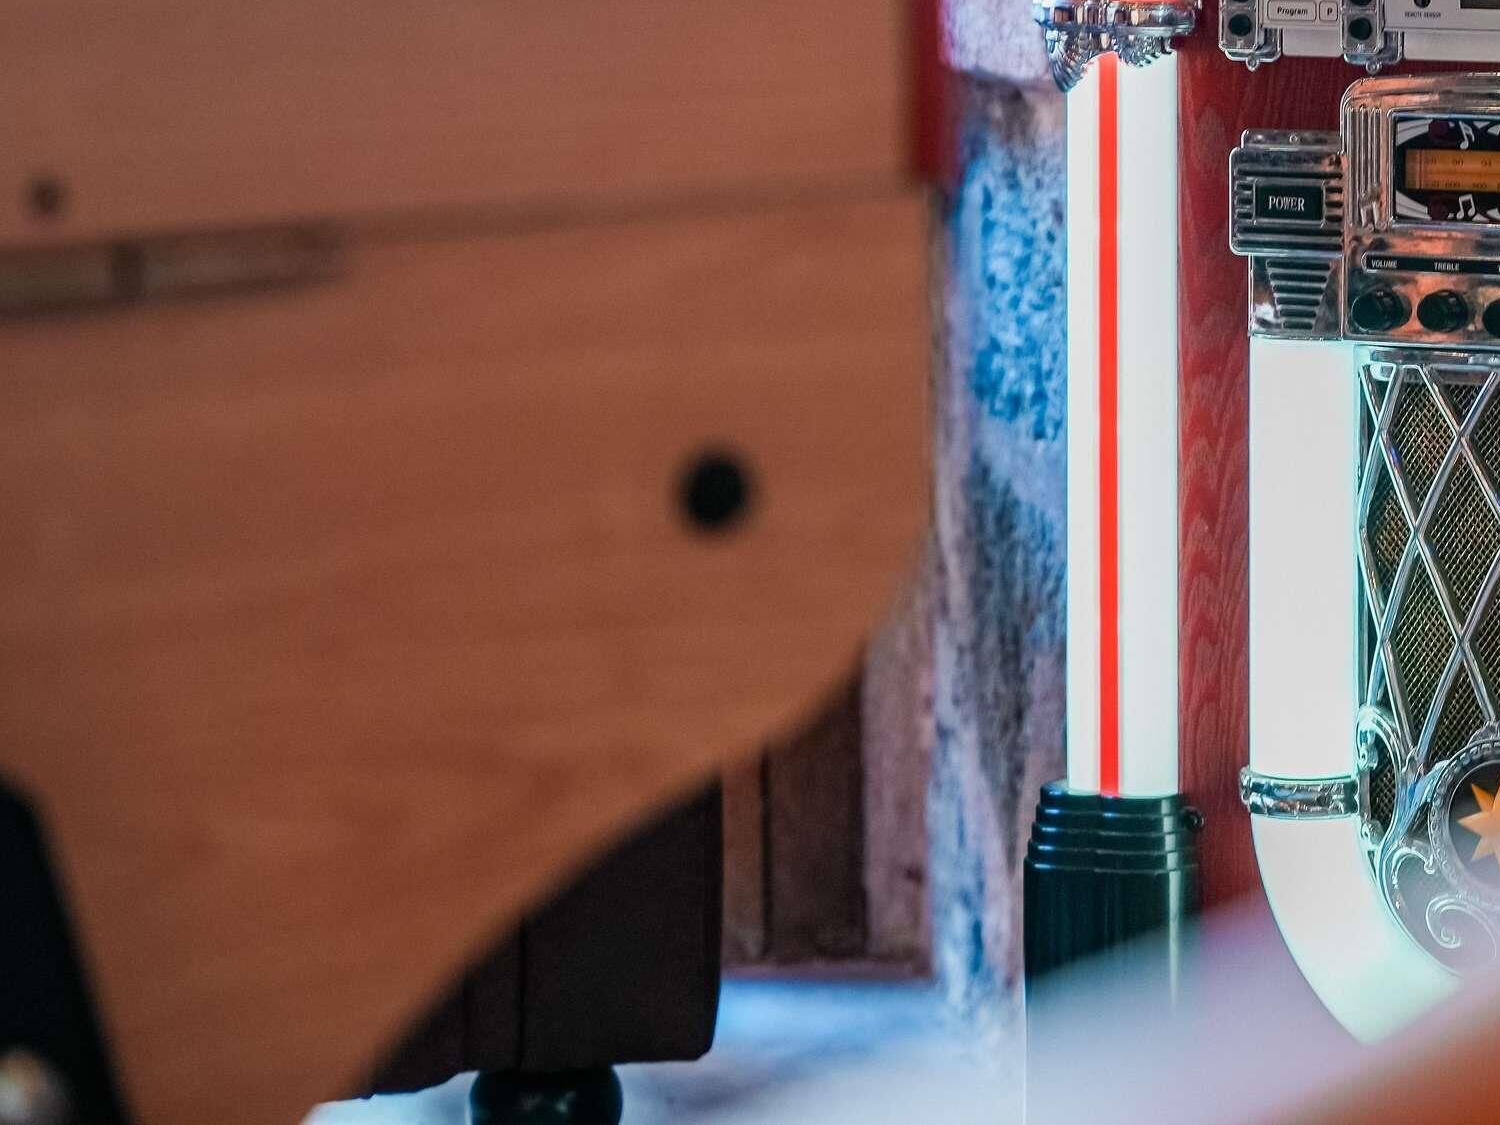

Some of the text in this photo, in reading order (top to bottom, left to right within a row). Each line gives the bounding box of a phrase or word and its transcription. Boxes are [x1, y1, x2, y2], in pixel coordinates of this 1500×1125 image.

[1277, 7, 1308, 17] Program
[1327, 8, 1333, 16] P
[1268, 195, 1305, 212] POWER
[1371, 259, 1398, 269] VOLUME
[1434, 261, 1460, 272] TREBLE
